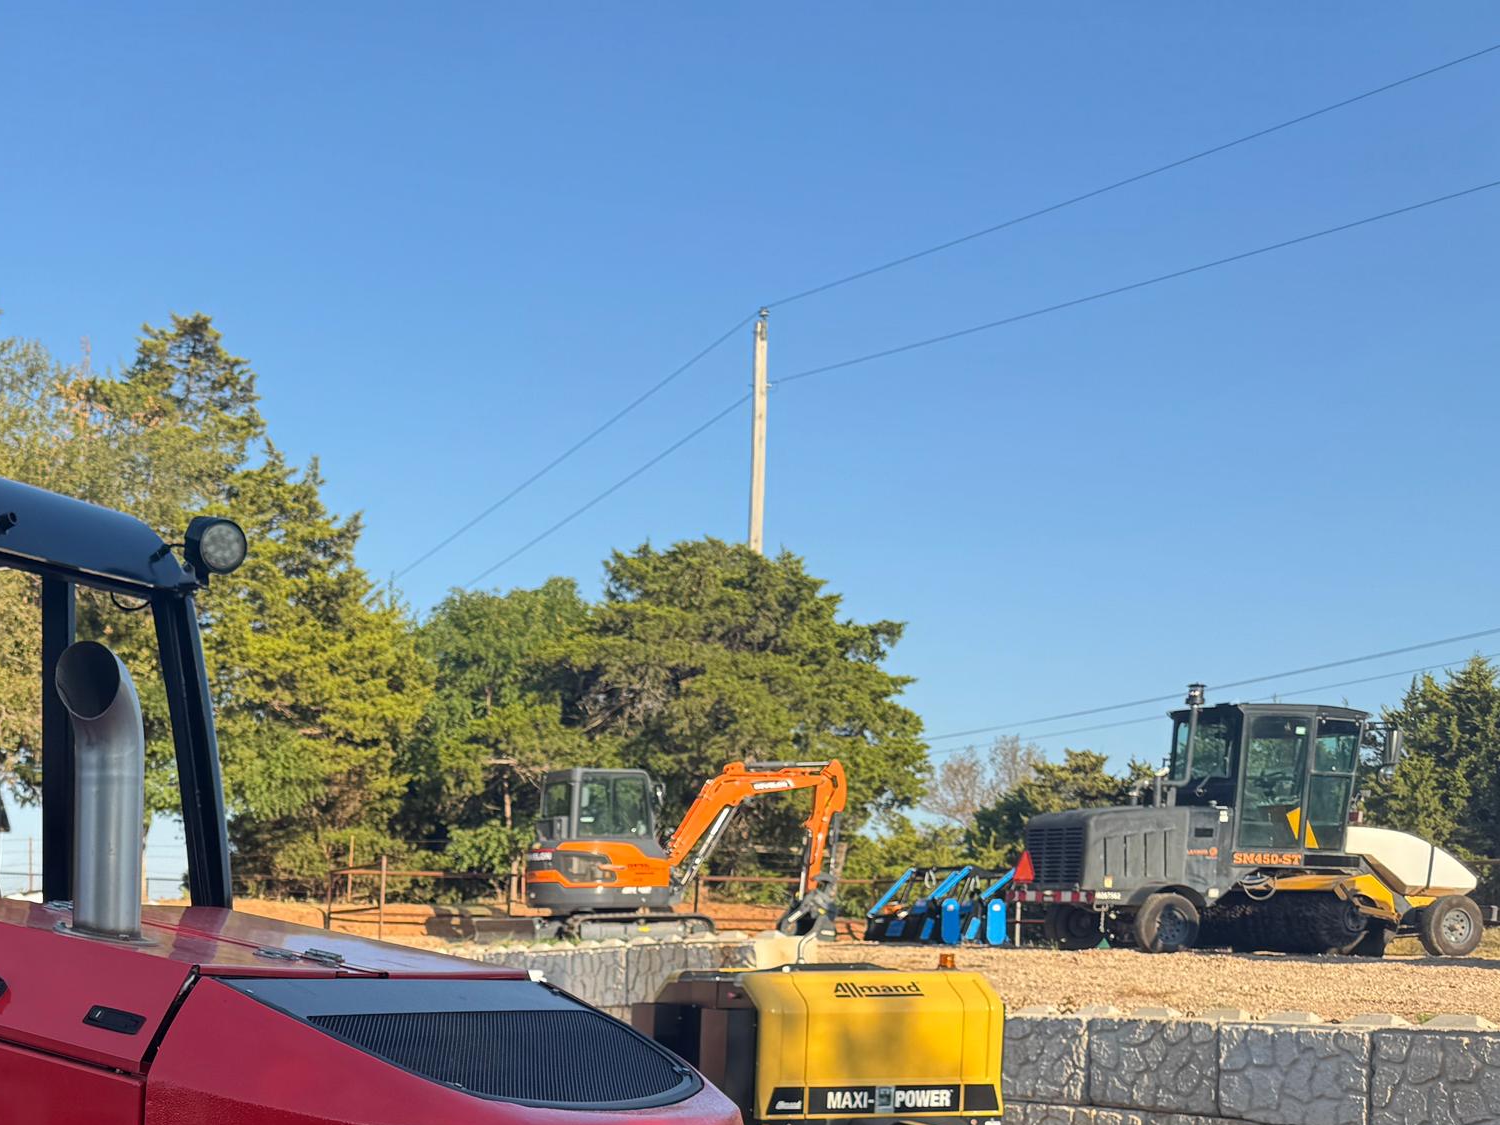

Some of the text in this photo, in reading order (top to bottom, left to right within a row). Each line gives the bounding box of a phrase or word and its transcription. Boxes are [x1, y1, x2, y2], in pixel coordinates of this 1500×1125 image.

[833, 981, 924, 998] Allmand
[826, 1089, 951, 1109] MAXI- POWER
